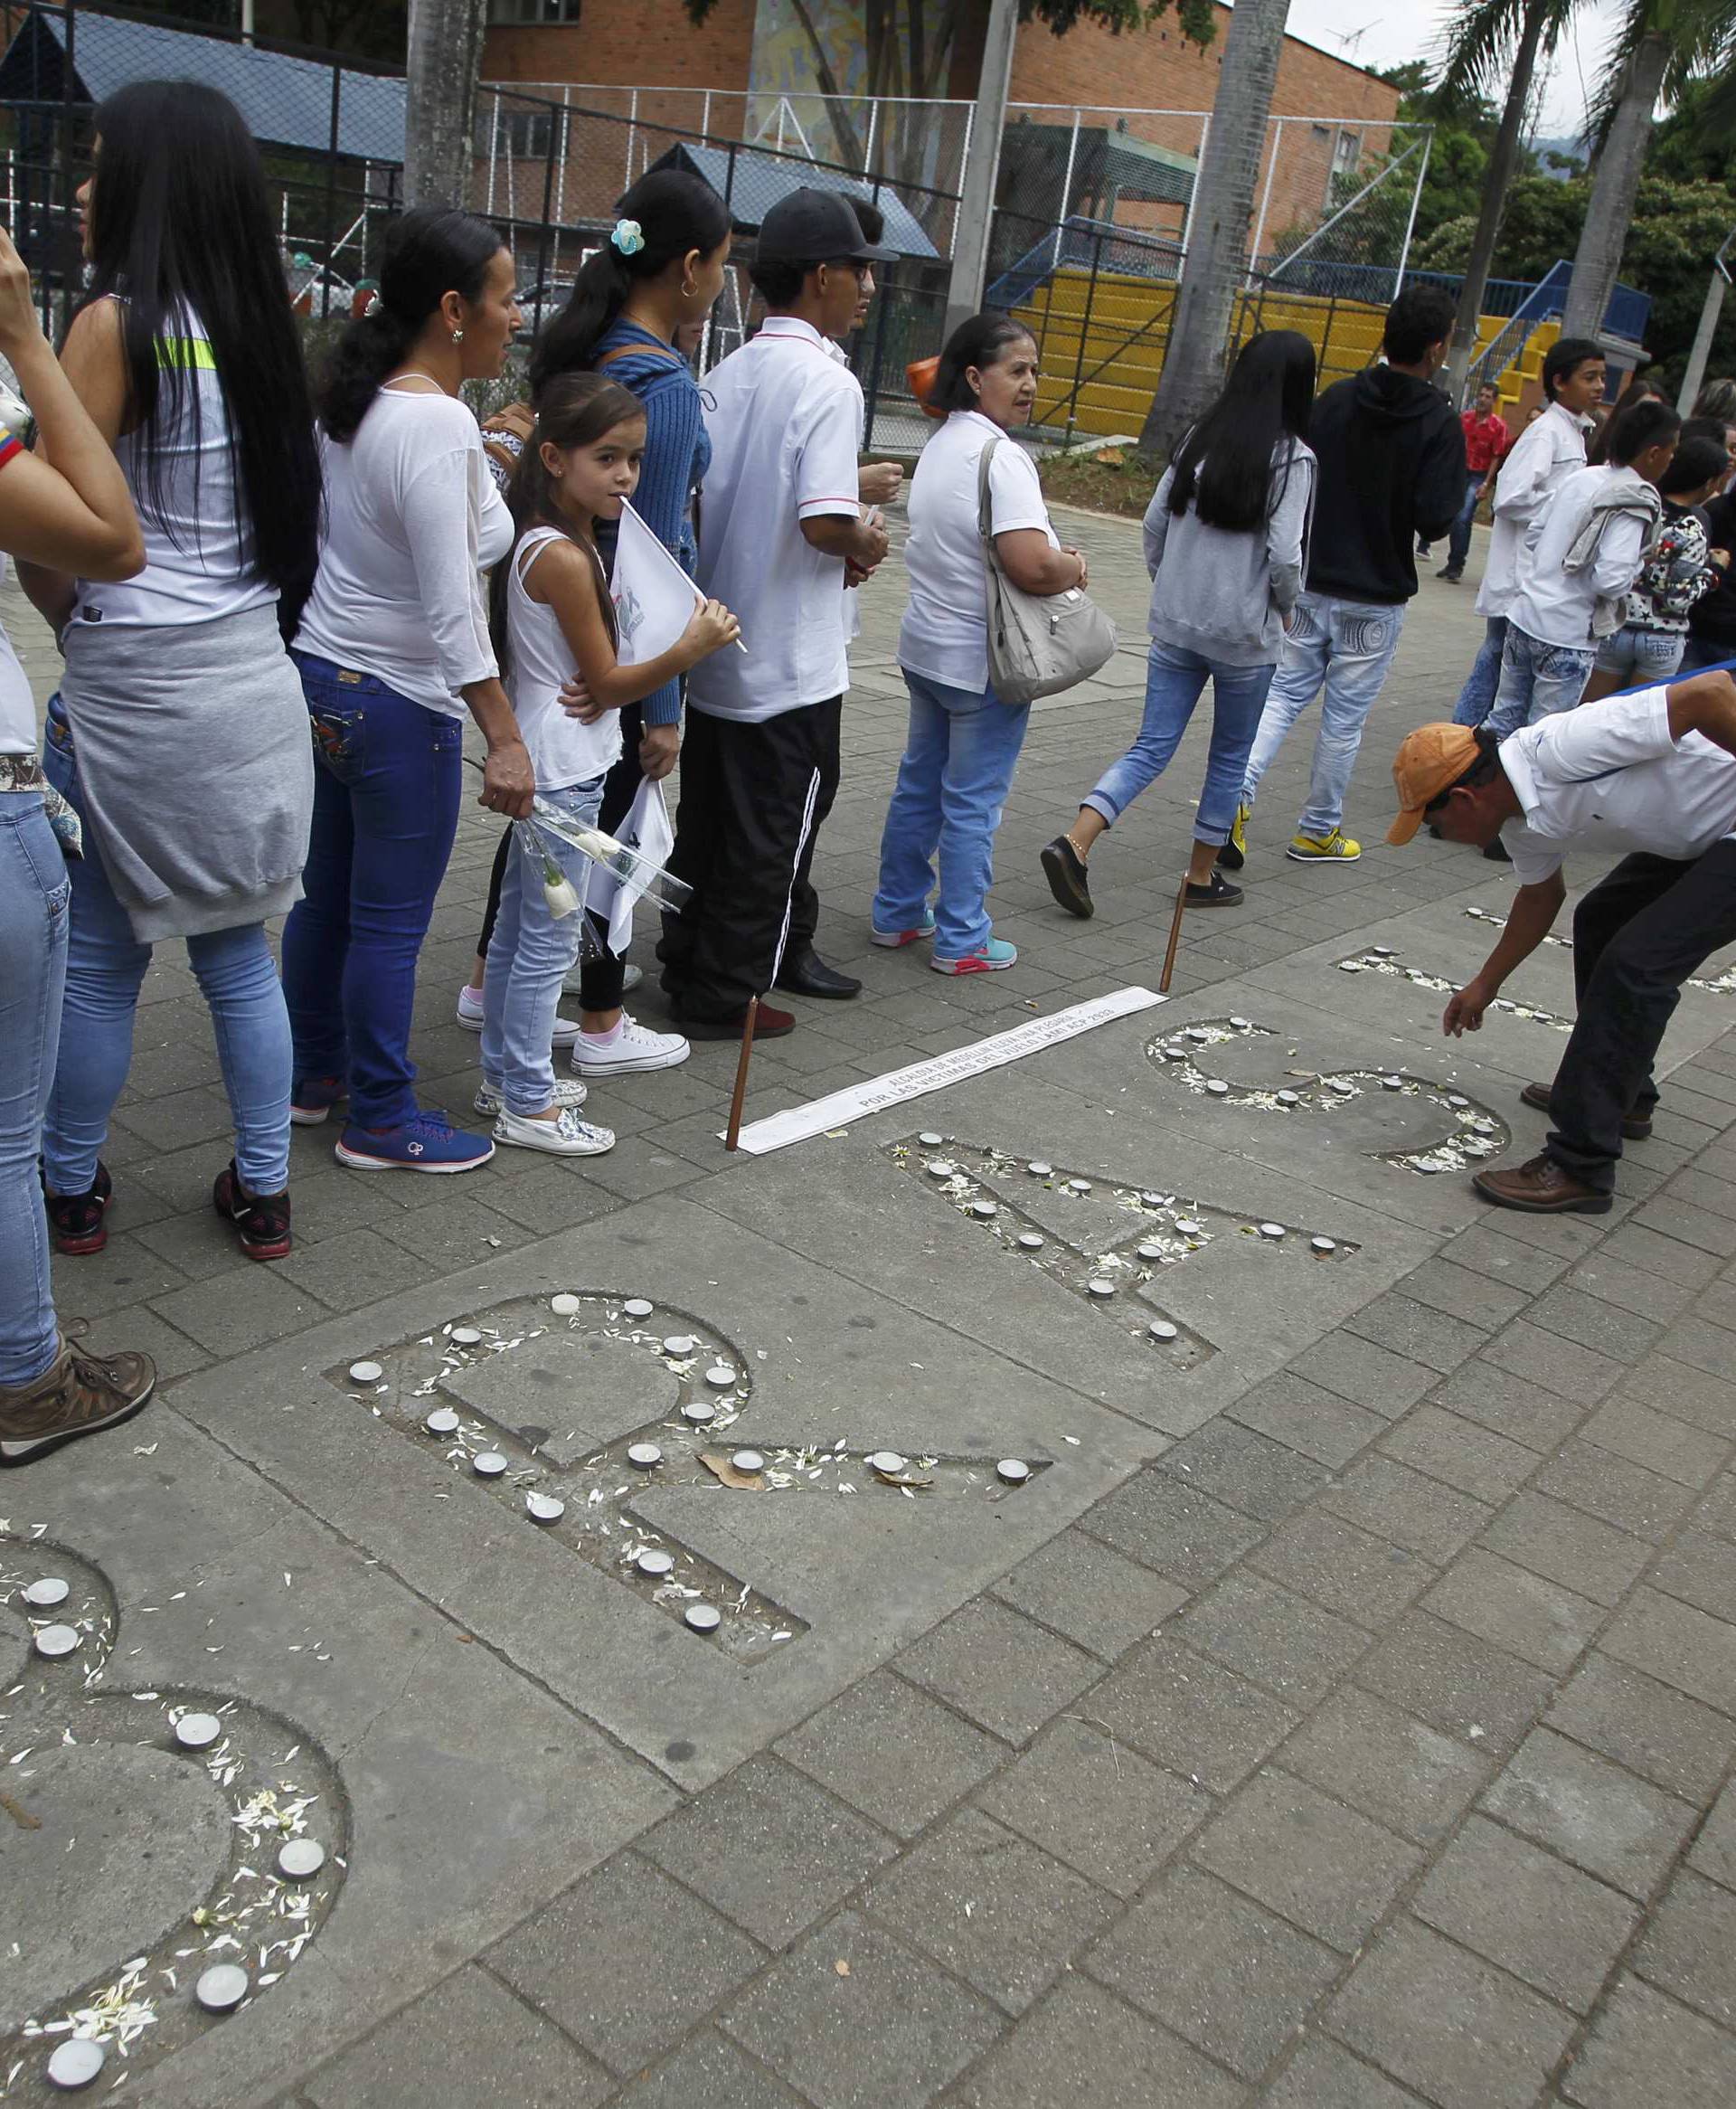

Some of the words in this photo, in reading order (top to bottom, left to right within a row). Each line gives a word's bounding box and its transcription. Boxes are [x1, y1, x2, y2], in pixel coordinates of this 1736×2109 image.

[859, 1092, 892, 1108] POR
[890, 1084, 919, 1097] LAS
[915, 1062, 978, 1086] VICTIMAS
[975, 1048, 1003, 1064] DEL
[1001, 1037, 1040, 1055] VUELO
[889, 1066, 936, 1086] ALCALDIA
[933, 1062, 948, 1071] DE
[946, 1045, 992, 1065] MEDELLIN
